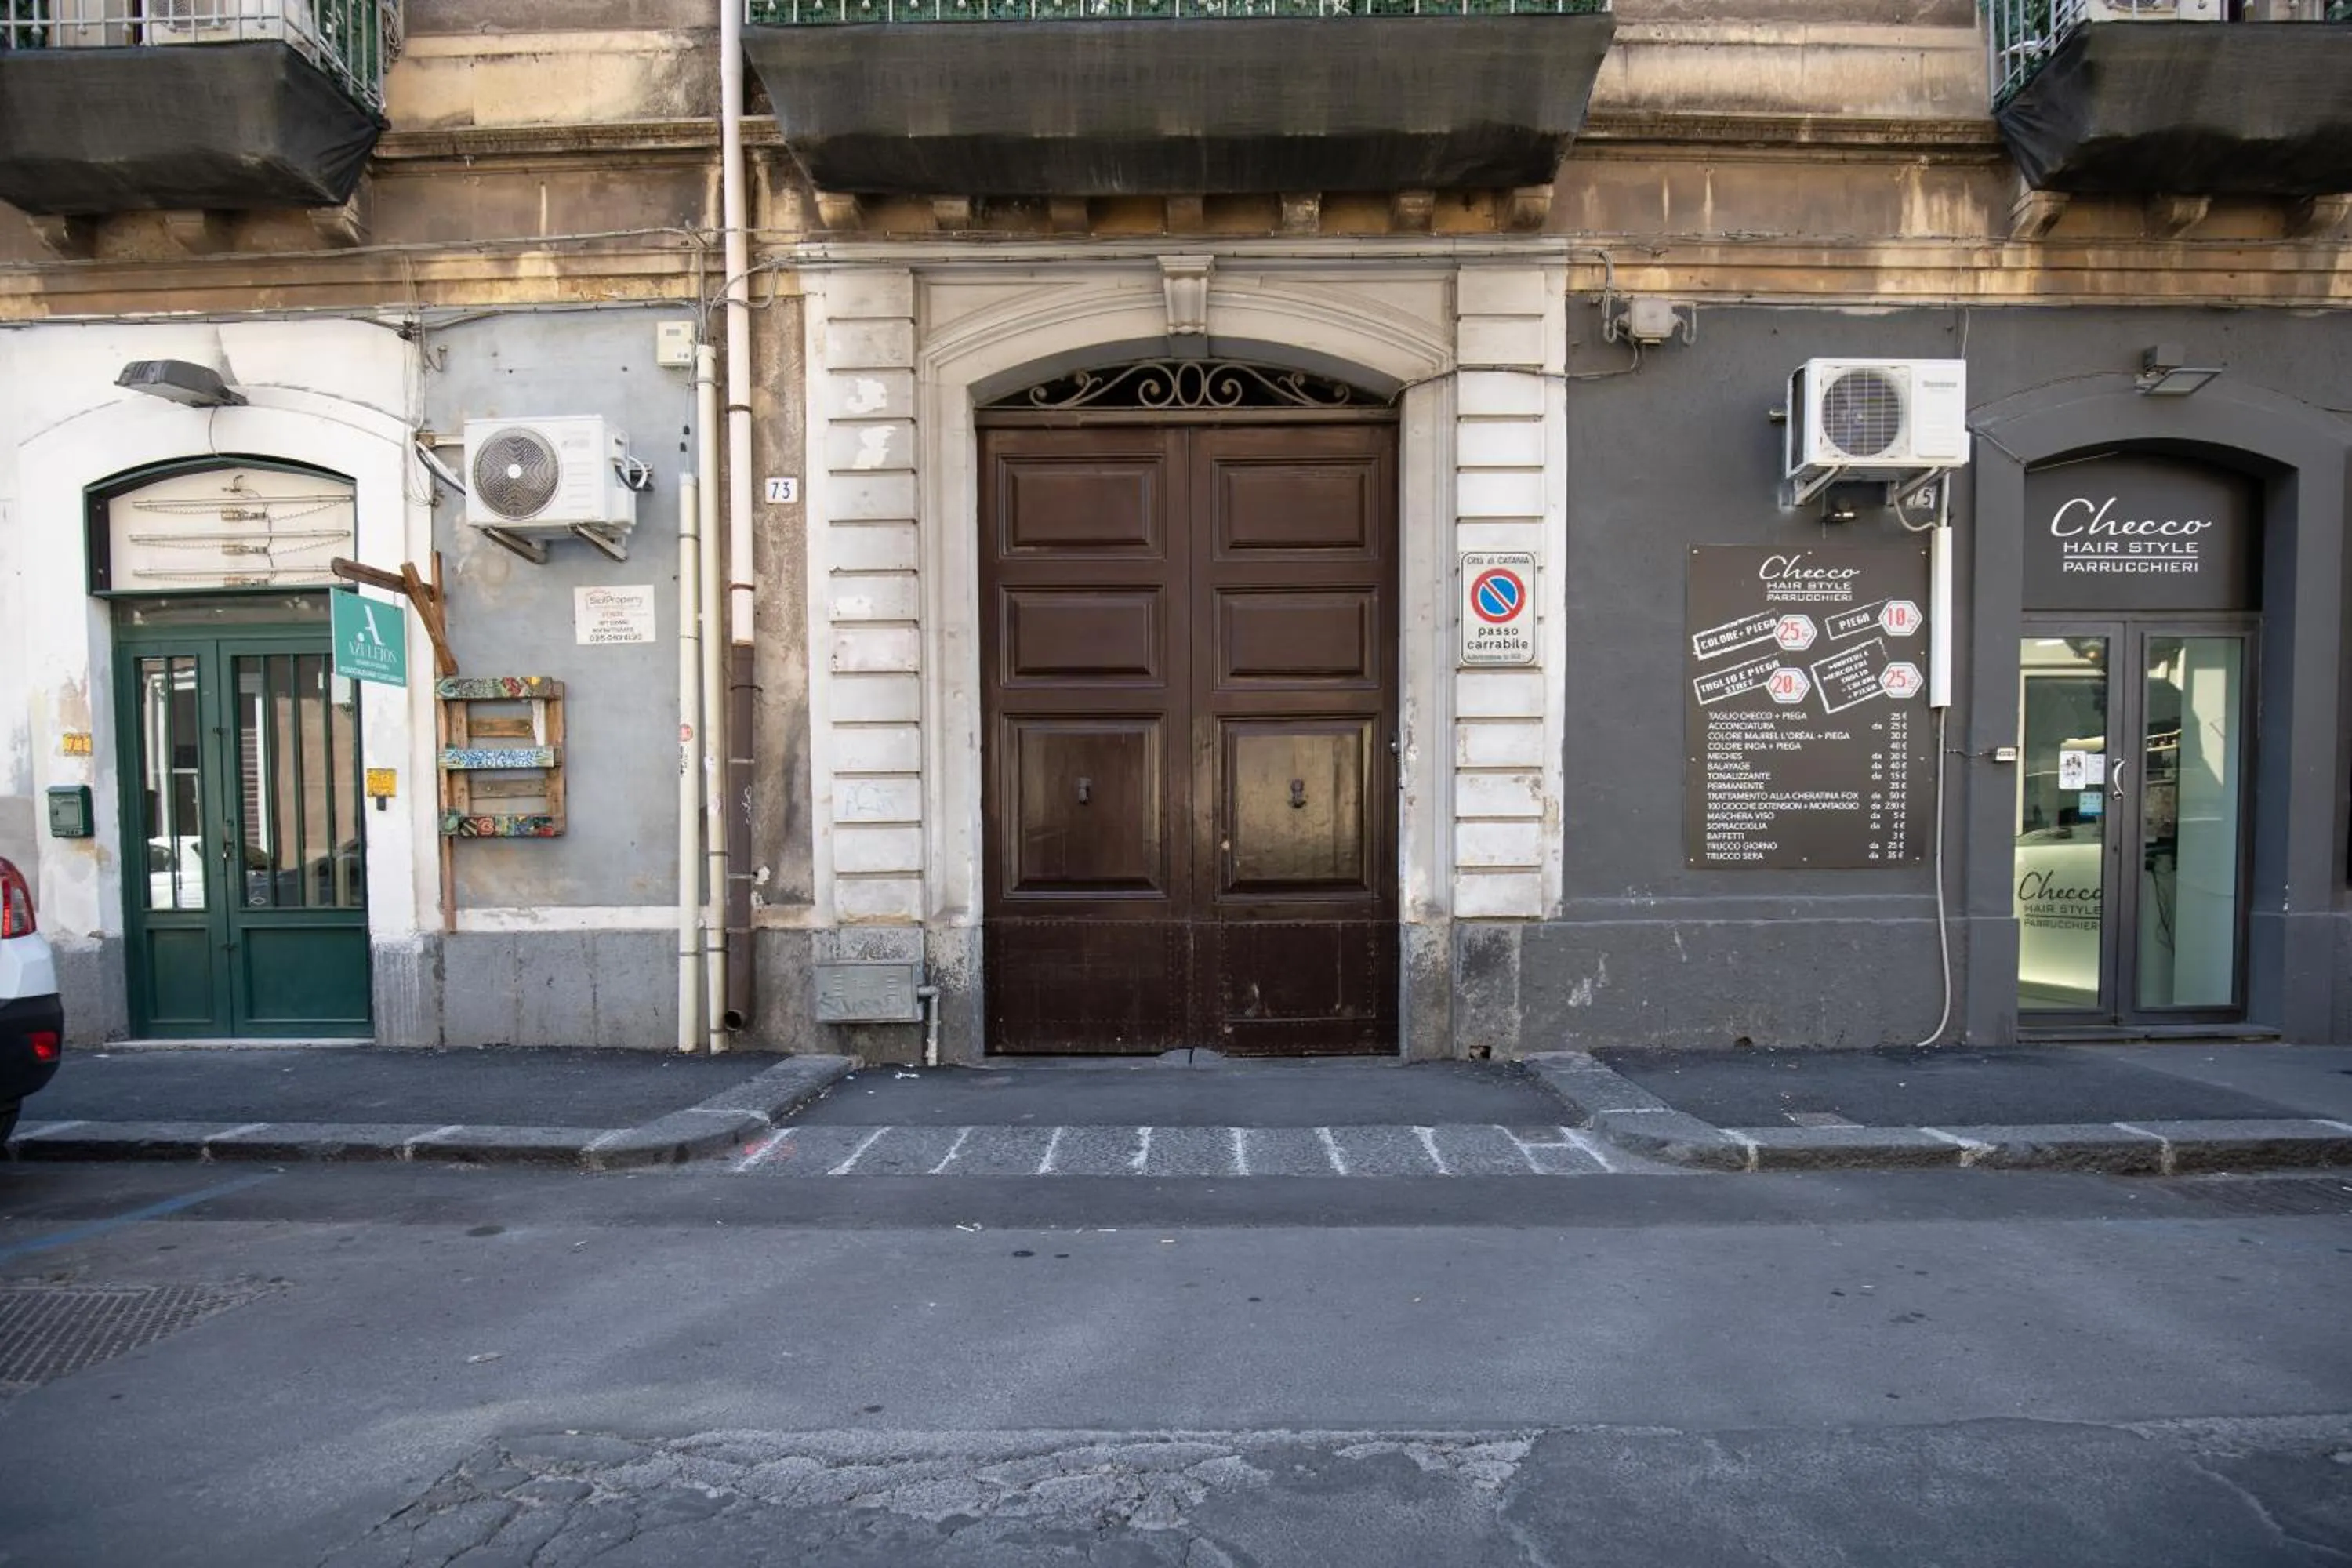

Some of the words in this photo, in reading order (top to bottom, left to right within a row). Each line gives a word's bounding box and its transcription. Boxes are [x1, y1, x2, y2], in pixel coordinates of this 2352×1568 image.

[771, 481, 792, 499] 73
[2050, 496, 2212, 537] Checco
[2063, 542, 2118, 553] HAIR
[2129, 542, 2199, 553] STYLE
[1759, 554, 1860, 580] Checco
[2063, 561, 2199, 572] PARRUCCHIERI
[1766, 581, 1802, 590] HAIR
[1807, 581, 1852, 590] STYLE
[1766, 593, 1853, 601] PARRUCCHIERI
[1838, 612, 1871, 630] PIEGA
[1478, 627, 1519, 638] passo
[1745, 618, 1777, 636] PIEGA
[1467, 638, 1529, 650] carrabile
[1700, 674, 1738, 693] TAGLIO
[1747, 659, 1780, 677] PIEGA
[1740, 711, 1773, 720] CHECCO
[1776, 742, 1802, 750] PIEGA
[2024, 904, 2055, 913] HAIR
[2060, 905, 2103, 915] STYLE
